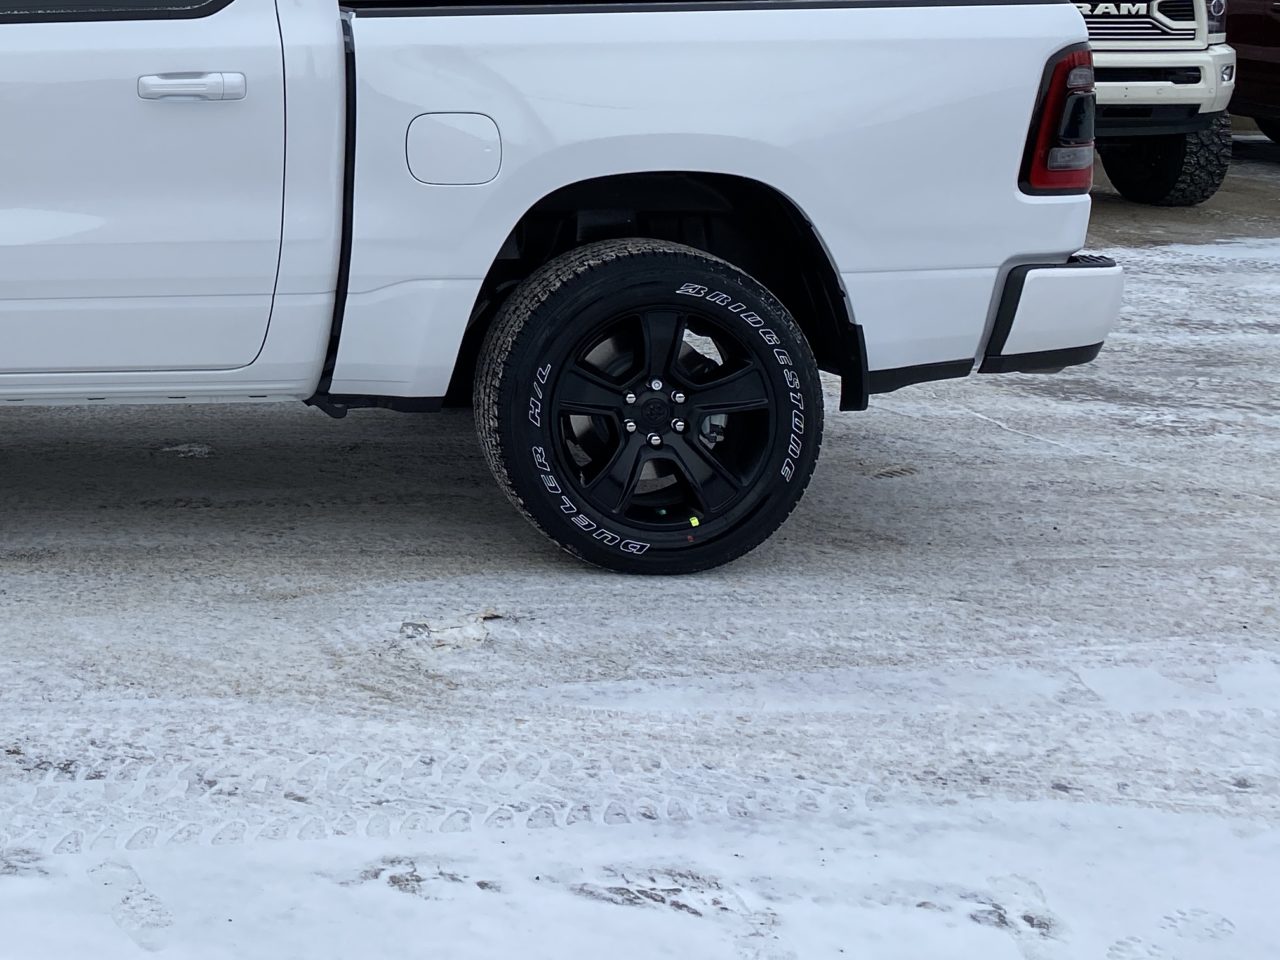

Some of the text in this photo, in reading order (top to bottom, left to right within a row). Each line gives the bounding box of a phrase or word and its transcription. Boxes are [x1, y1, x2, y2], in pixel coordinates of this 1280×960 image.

[528, 363, 651, 556] DUELER H/L
[675, 282, 807, 483] BRIDGESTONE
